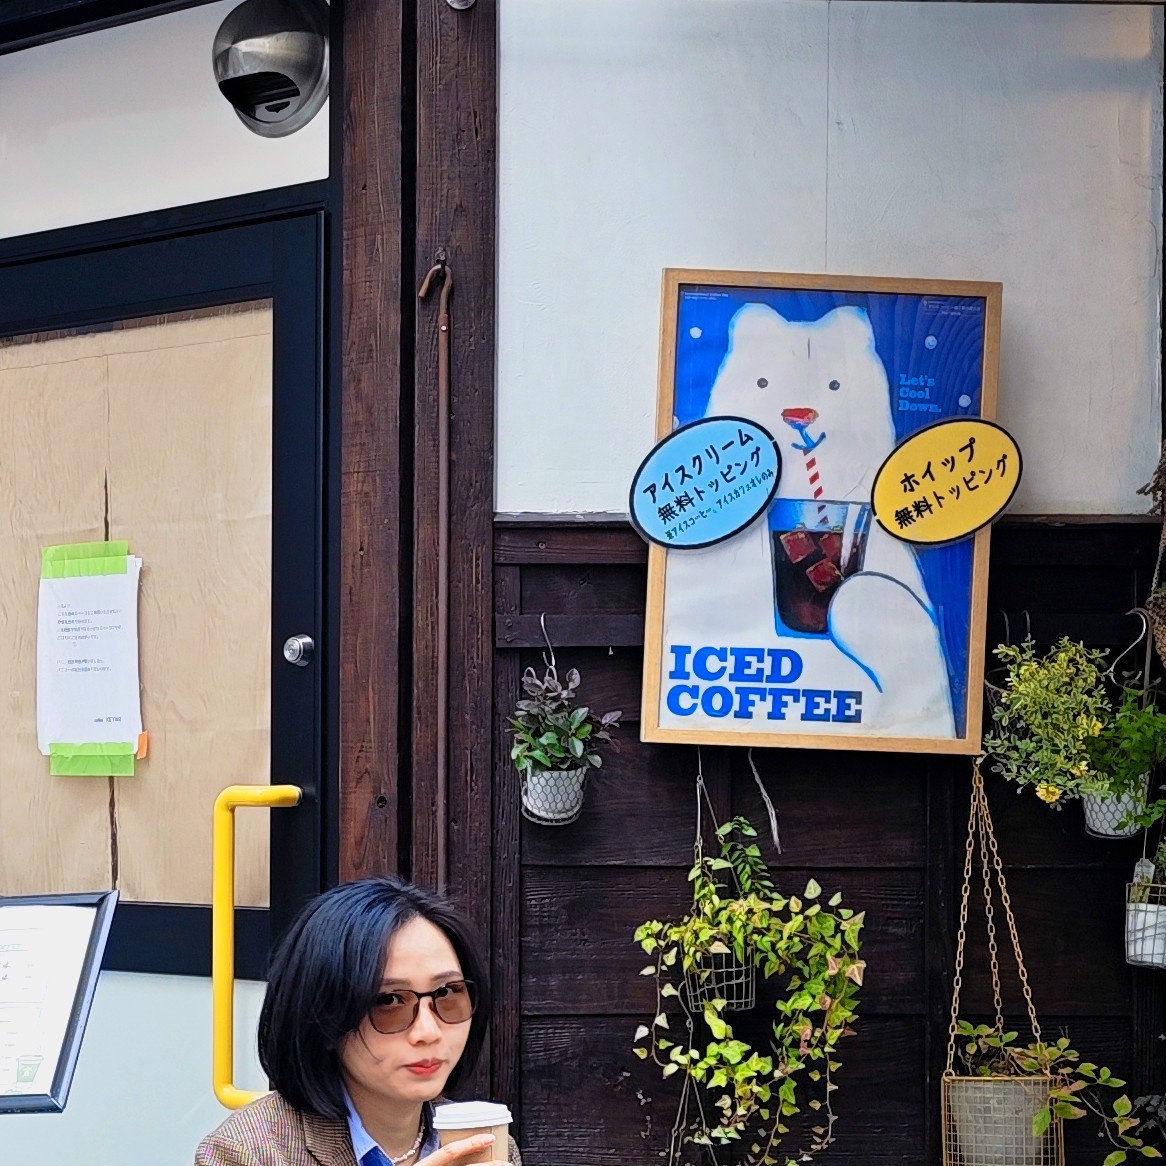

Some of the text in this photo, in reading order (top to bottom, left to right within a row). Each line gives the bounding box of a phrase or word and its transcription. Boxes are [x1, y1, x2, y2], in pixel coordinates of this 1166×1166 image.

[899, 374, 936, 387] Let's
[899, 387, 931, 399] Cool
[898, 400, 942, 413] Down.
[643, 428, 754, 504] アイスクリーム
[900, 436, 976, 493] ホイップ
[657, 446, 761, 525] 無料トッピング
[894, 453, 1008, 530] 無料トッピング
[669, 644, 804, 684] ICED
[666, 684, 863, 724] COFFEE
